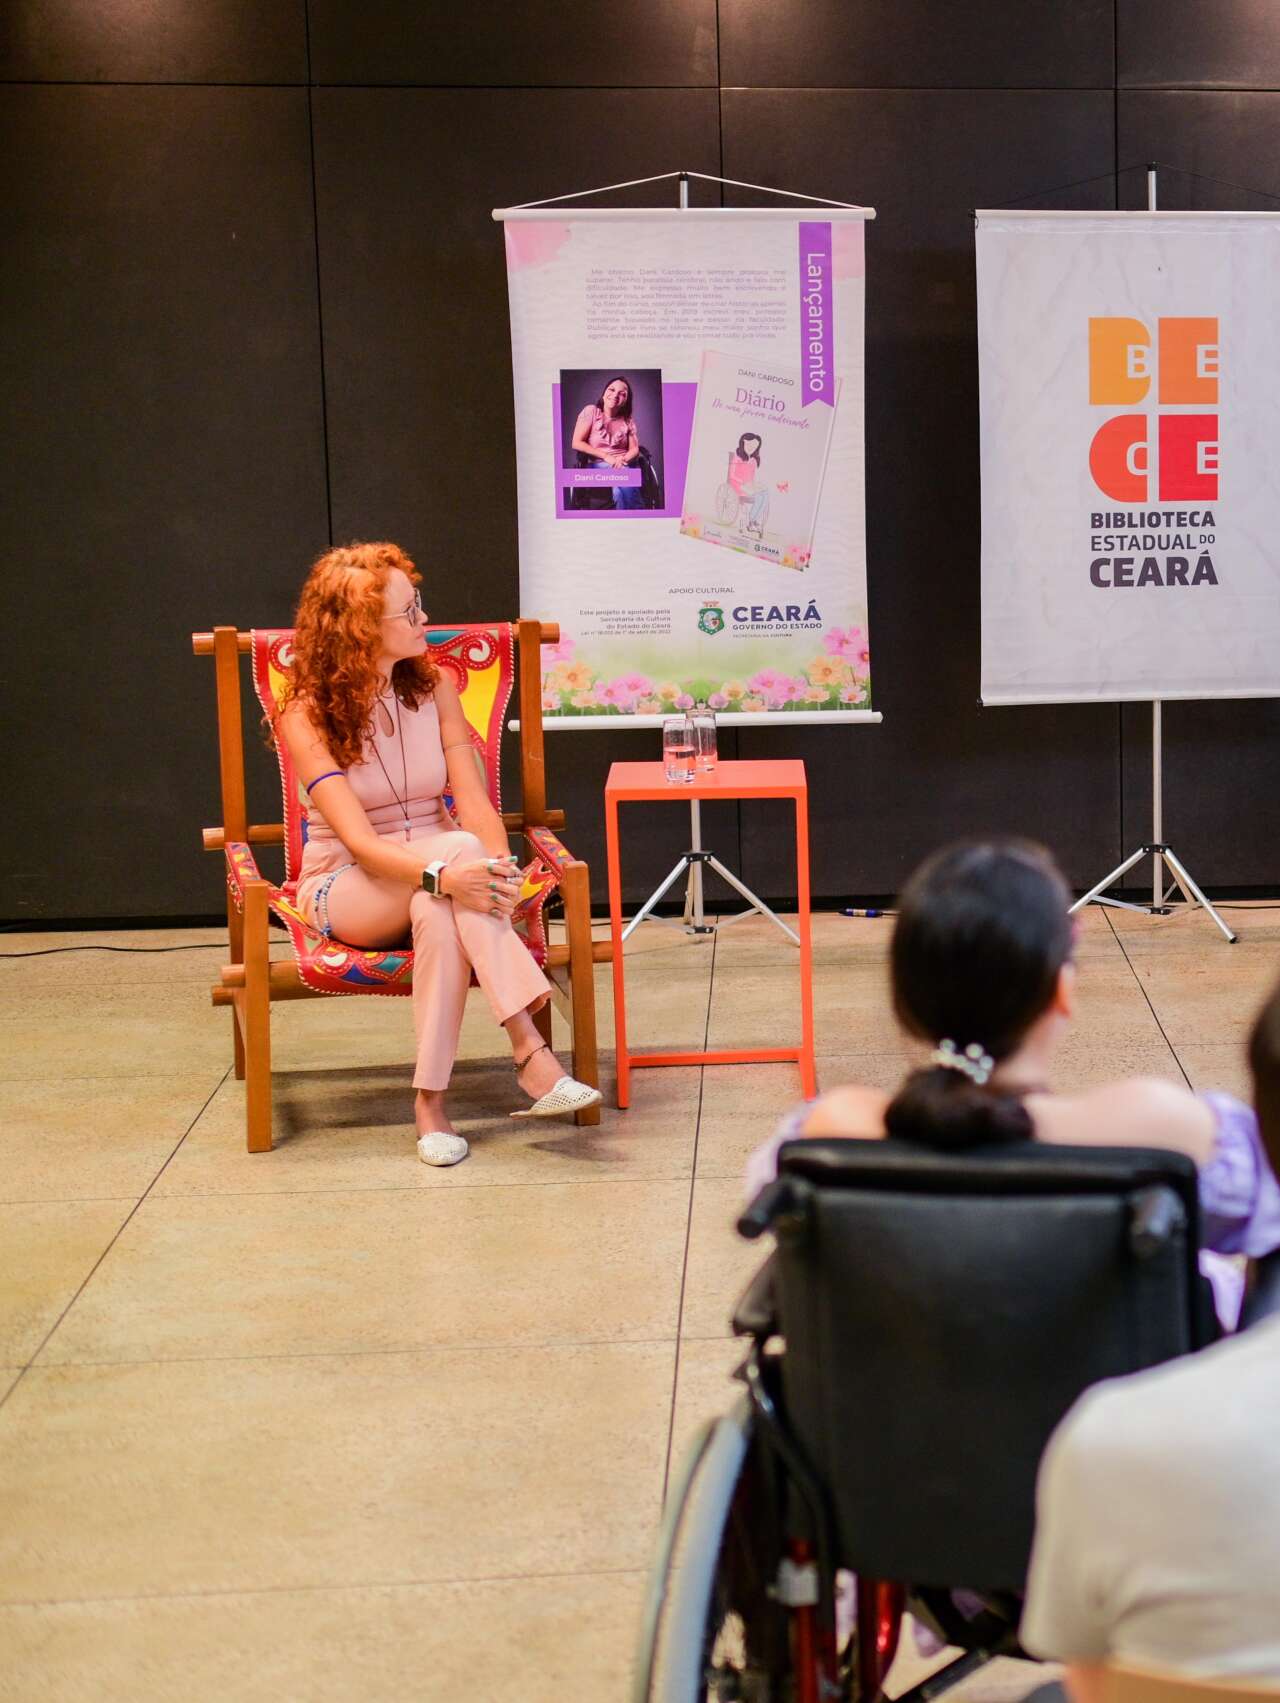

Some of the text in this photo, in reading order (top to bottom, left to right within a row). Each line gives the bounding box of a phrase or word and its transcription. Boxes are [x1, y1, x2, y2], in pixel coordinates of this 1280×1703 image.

[803, 252, 826, 393] Lançamento
[757, 372, 795, 387] CARDOSO
[735, 387, 786, 413] Diário
[574, 473, 629, 481] Dani Cardoso
[1090, 510, 1217, 530] BIBLIOTECA
[1090, 533, 1216, 552] ESTADUAL DO
[1089, 549, 1219, 588] CEARÁ
[668, 586, 735, 595] APOIO CULTURAL
[732, 598, 822, 623] CEARÁ
[732, 623, 774, 631] GOVERNO
[790, 622, 823, 630] ESTADO
